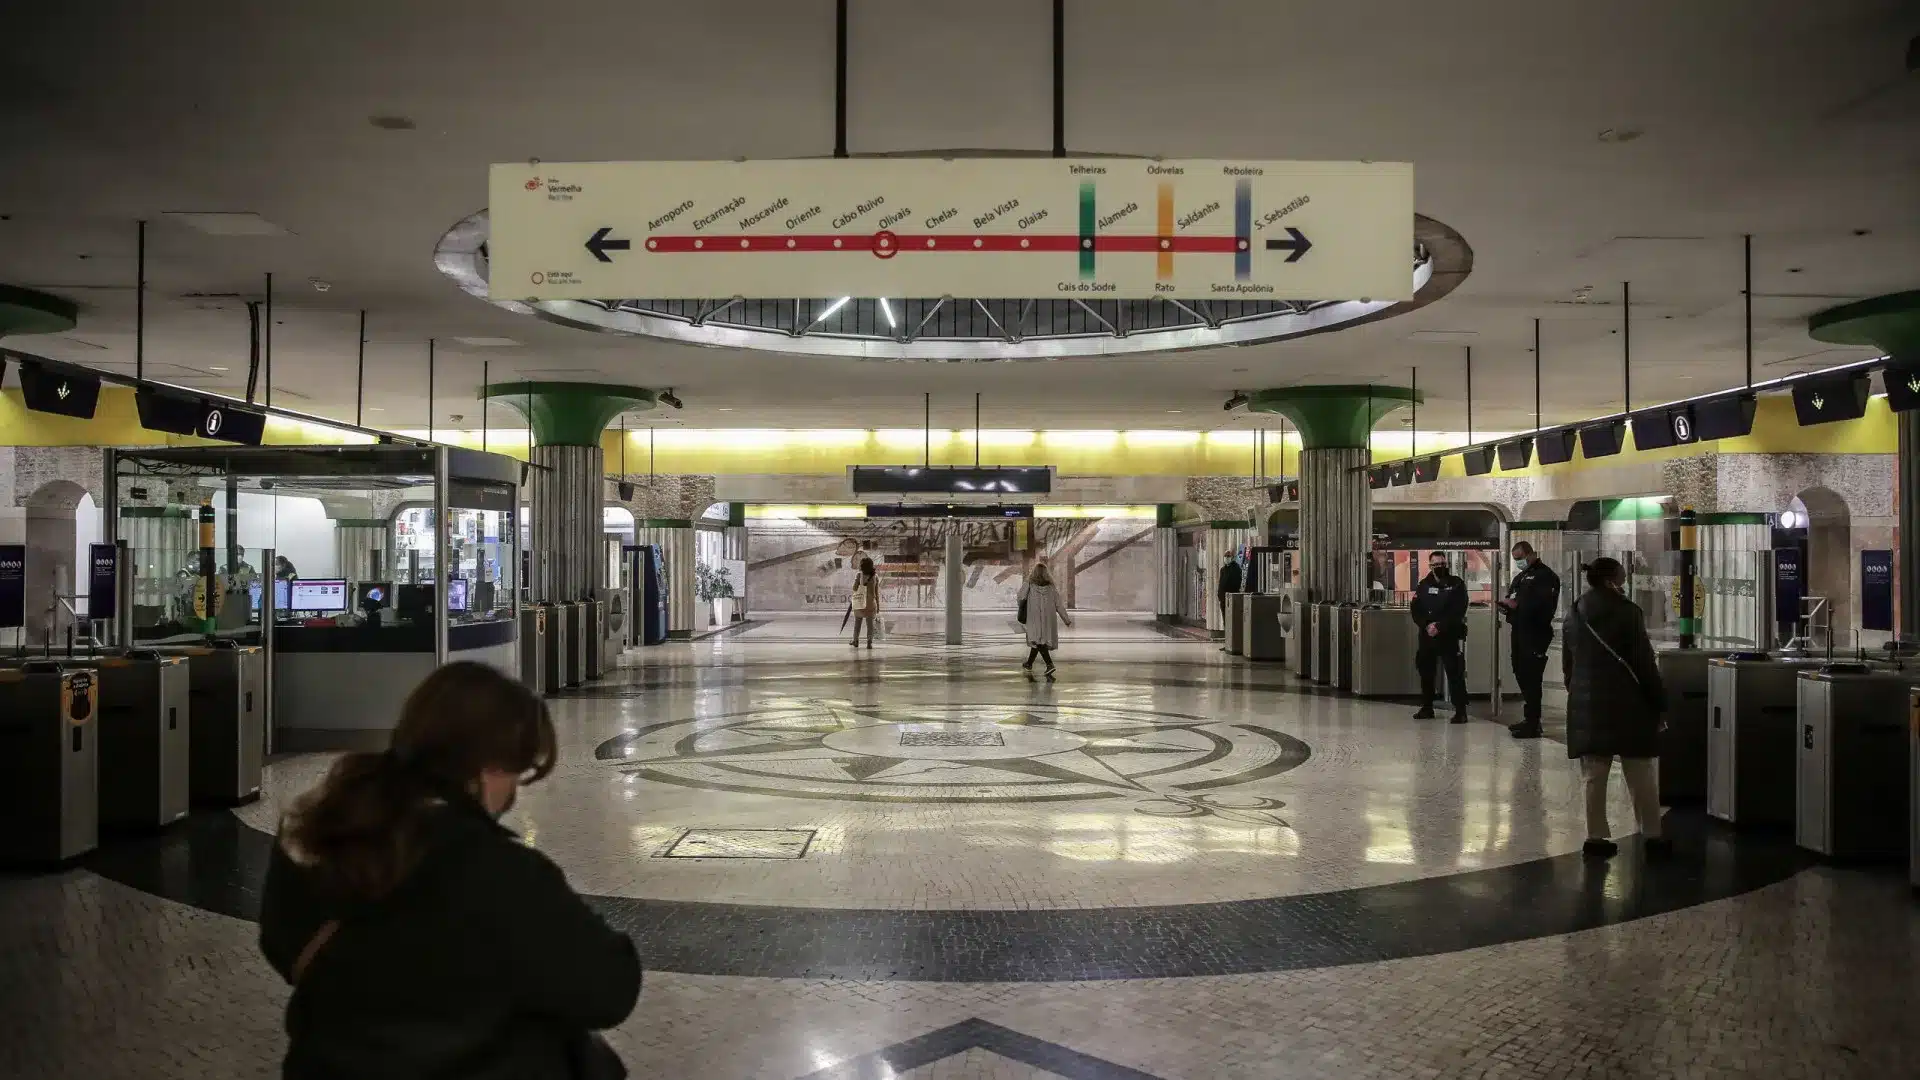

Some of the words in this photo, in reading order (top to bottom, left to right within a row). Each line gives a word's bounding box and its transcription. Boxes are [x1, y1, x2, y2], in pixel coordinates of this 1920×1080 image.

[1069, 164, 1106, 175] Telheiras
[1147, 164, 1184, 175] Odivelas
[1224, 165, 1263, 176] Reboleira
[648, 200, 694, 231] Aeroporto
[693, 197, 748, 230] Encarnação
[739, 197, 789, 230] Moscavide
[785, 204, 821, 229] Oriente
[833, 212, 856, 229] Cabo
[857, 196, 884, 215] Ruivo
[879, 208, 911, 229] Olivais
[926, 208, 958, 228] Chelas
[973, 210, 996, 228] Bela
[994, 200, 1019, 217] Vista
[1018, 210, 1048, 229] Olaias
[1097, 203, 1137, 229] Alameda
[1178, 202, 1220, 229] Saldanha
[1254, 219, 1264, 231] S.
[1264, 196, 1310, 224] Sebastião
[1058, 281, 1076, 292] Cais
[1078, 282, 1088, 292] do
[1092, 282, 1116, 292] Sodré
[1155, 282, 1175, 293] Rato
[1212, 283, 1235, 293] Santa
[1236, 283, 1273, 295] Apolónia
